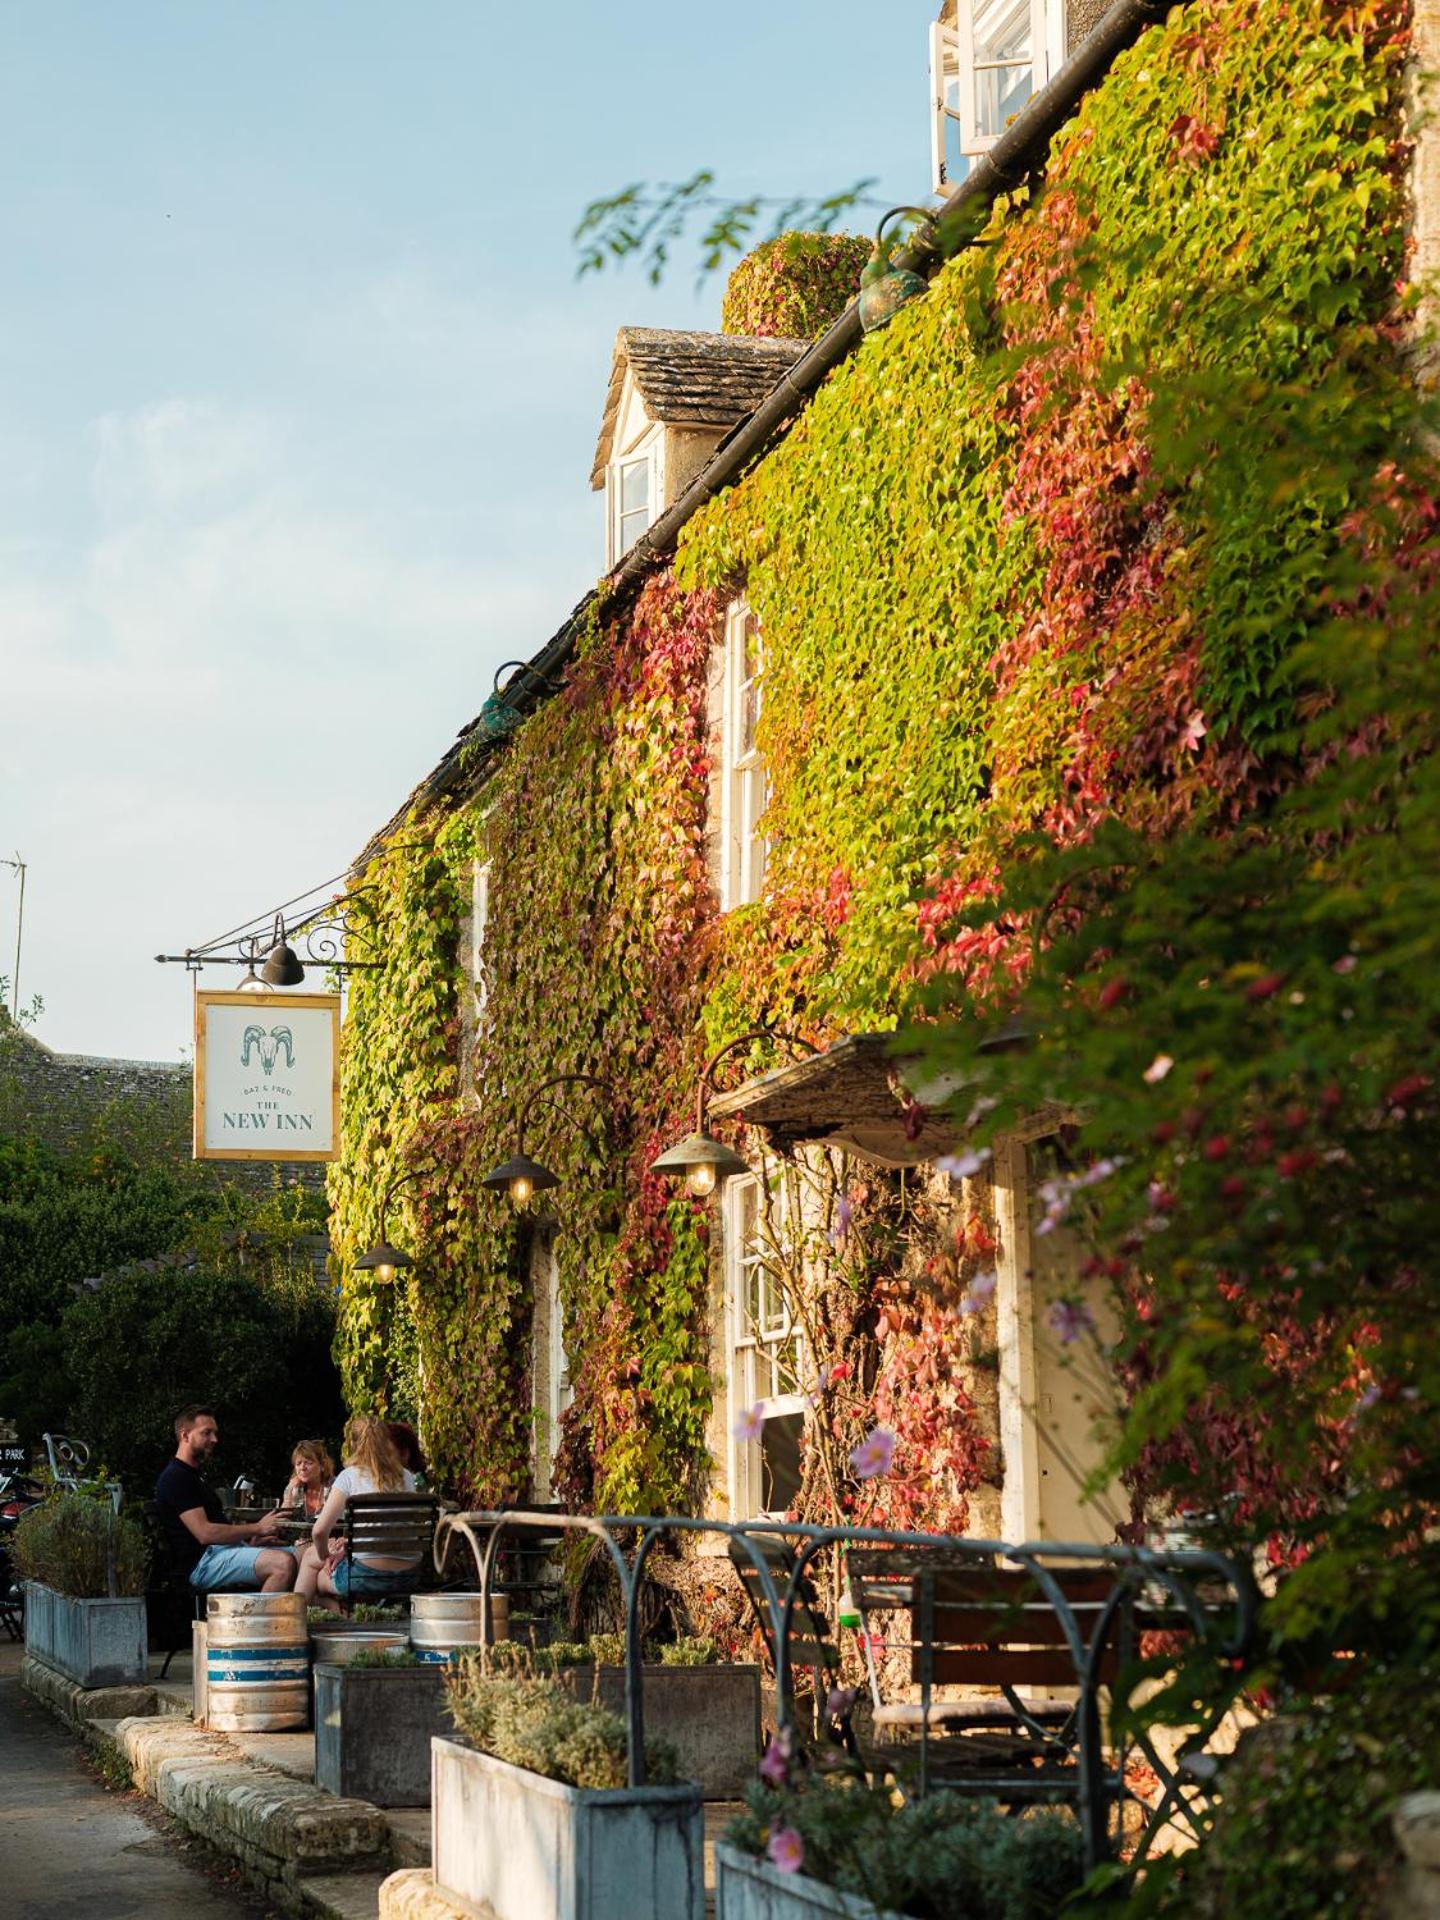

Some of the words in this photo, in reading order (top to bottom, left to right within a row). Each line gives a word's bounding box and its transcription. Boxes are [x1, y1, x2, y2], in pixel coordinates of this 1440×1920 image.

[257, 1101, 279, 1109] THE
[223, 1112, 269, 1129] NEW
[276, 1114, 312, 1130] INN
[5, 1448, 25, 1460] PARK
